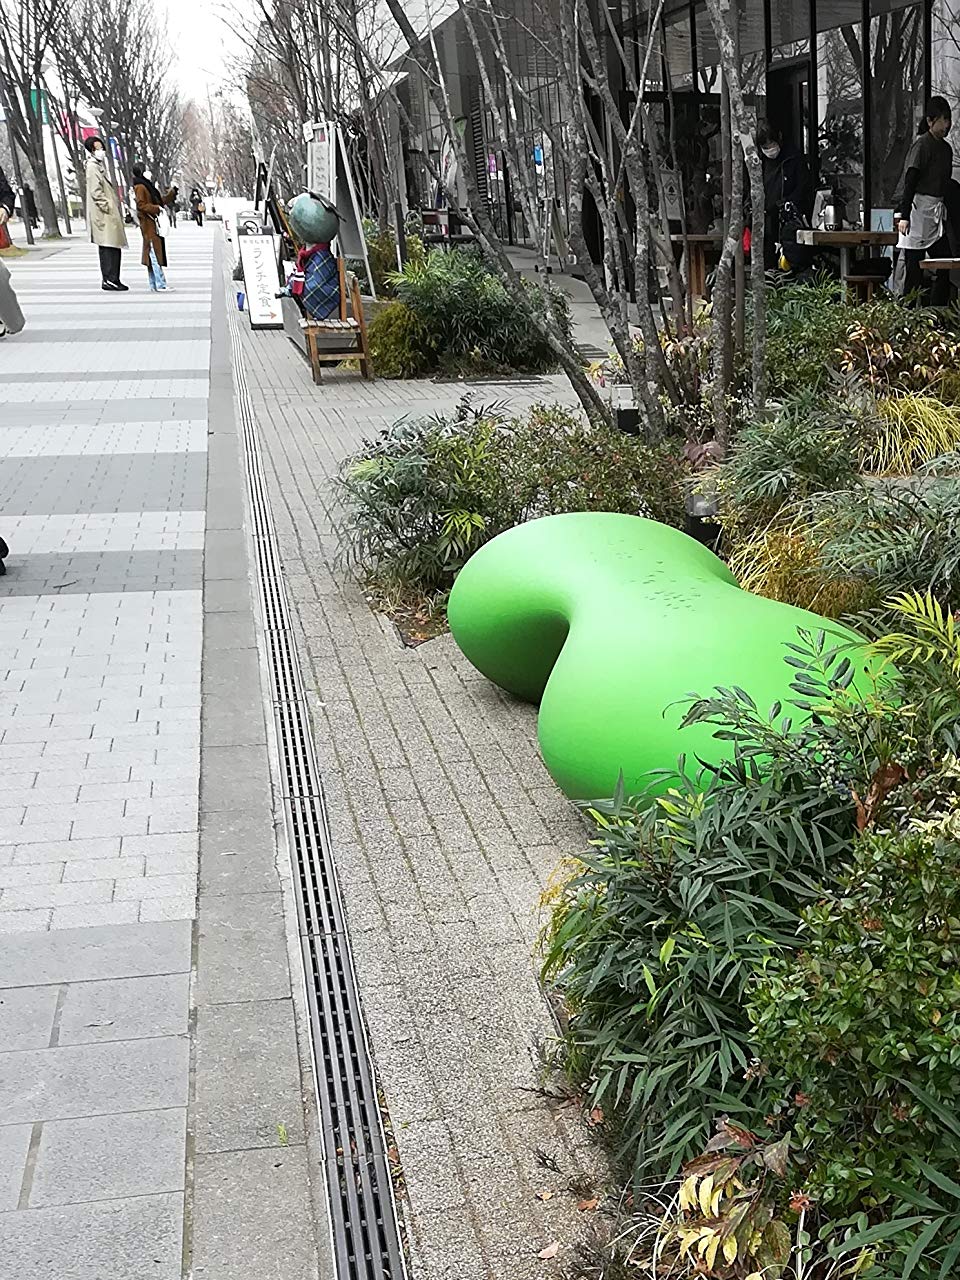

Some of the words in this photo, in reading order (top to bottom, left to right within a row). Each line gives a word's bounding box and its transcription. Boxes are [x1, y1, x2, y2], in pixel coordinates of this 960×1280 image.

[253, 247, 271, 308] ランチ定食
